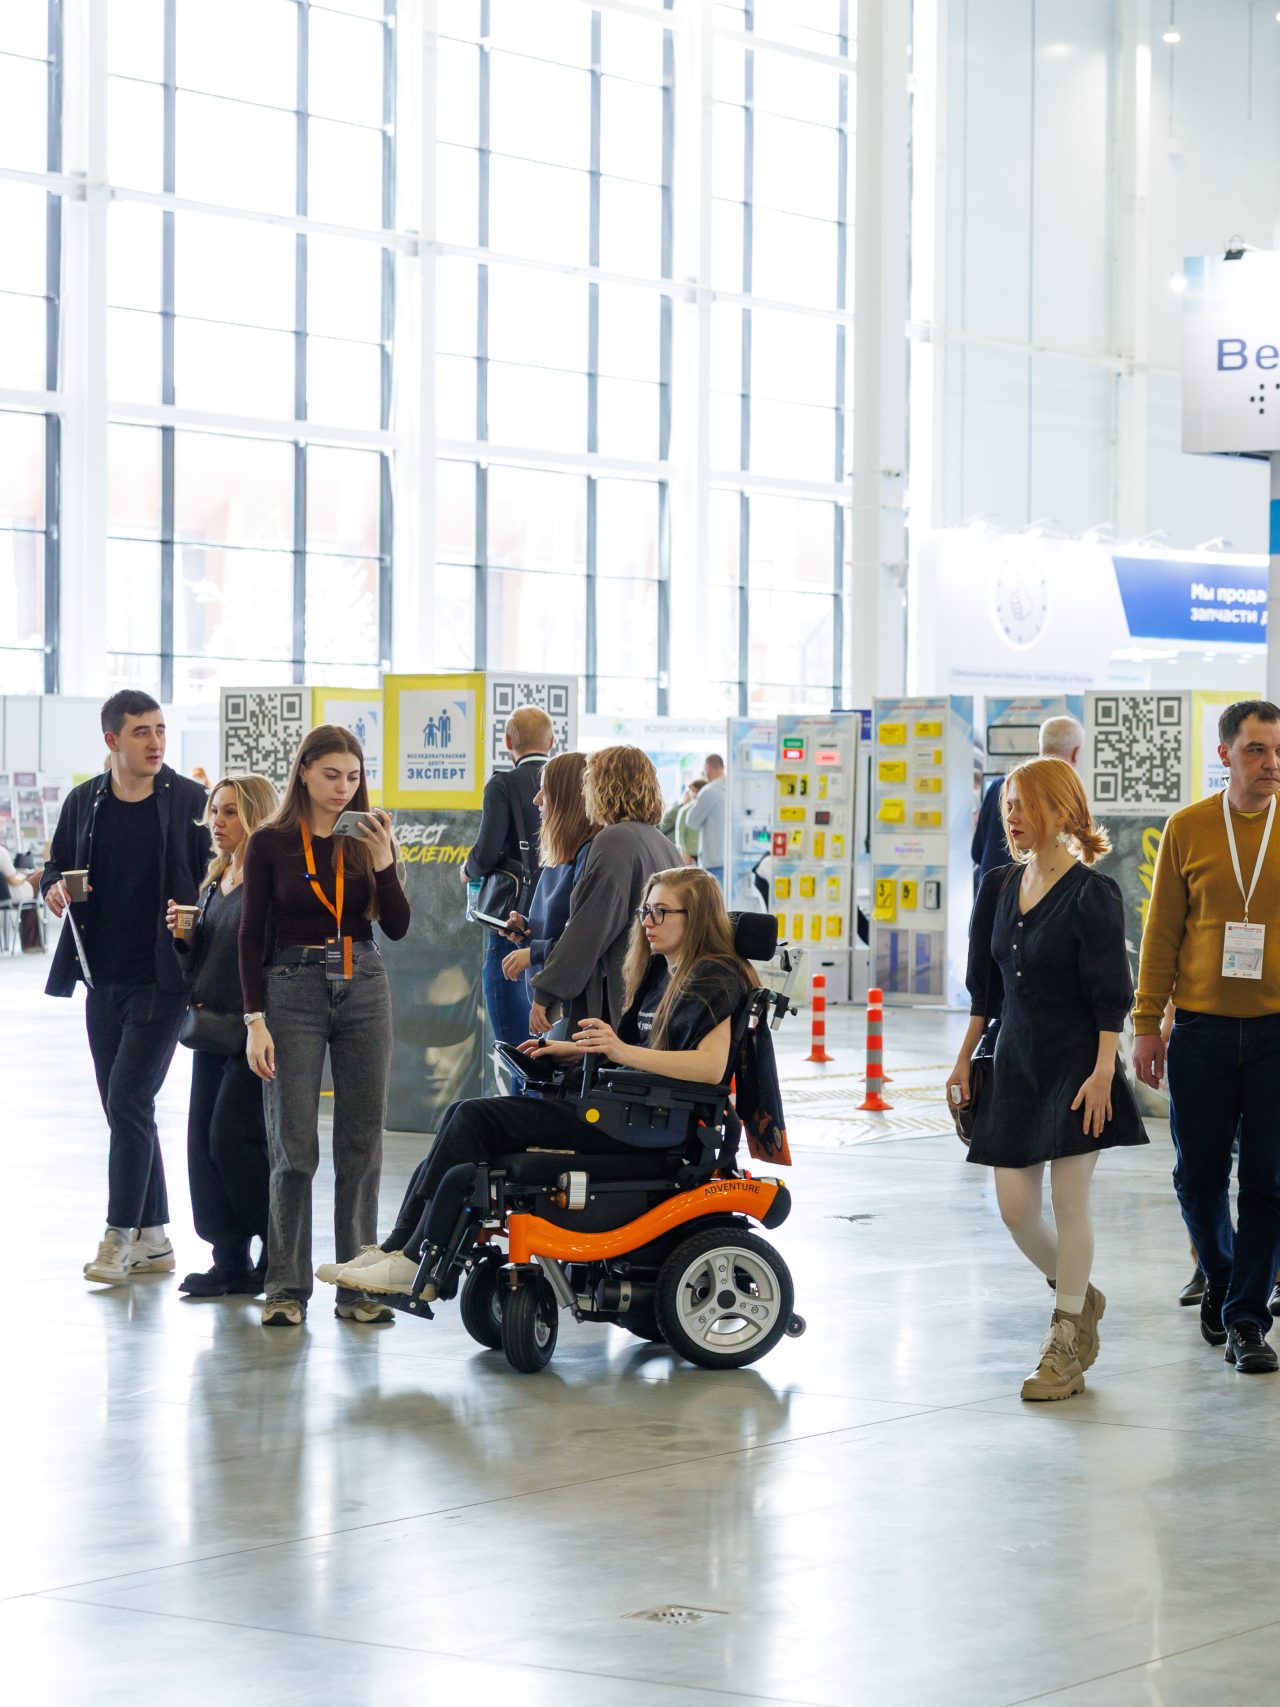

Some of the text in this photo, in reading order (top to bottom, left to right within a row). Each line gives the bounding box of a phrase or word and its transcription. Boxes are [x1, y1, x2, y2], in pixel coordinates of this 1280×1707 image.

[1191, 582, 1267, 605] Мы прода
[1190, 607, 1258, 624] запчасти
[407, 768, 466, 780] ЭКСПЕРТ
[704, 1182, 761, 1196] ADVENTURE
